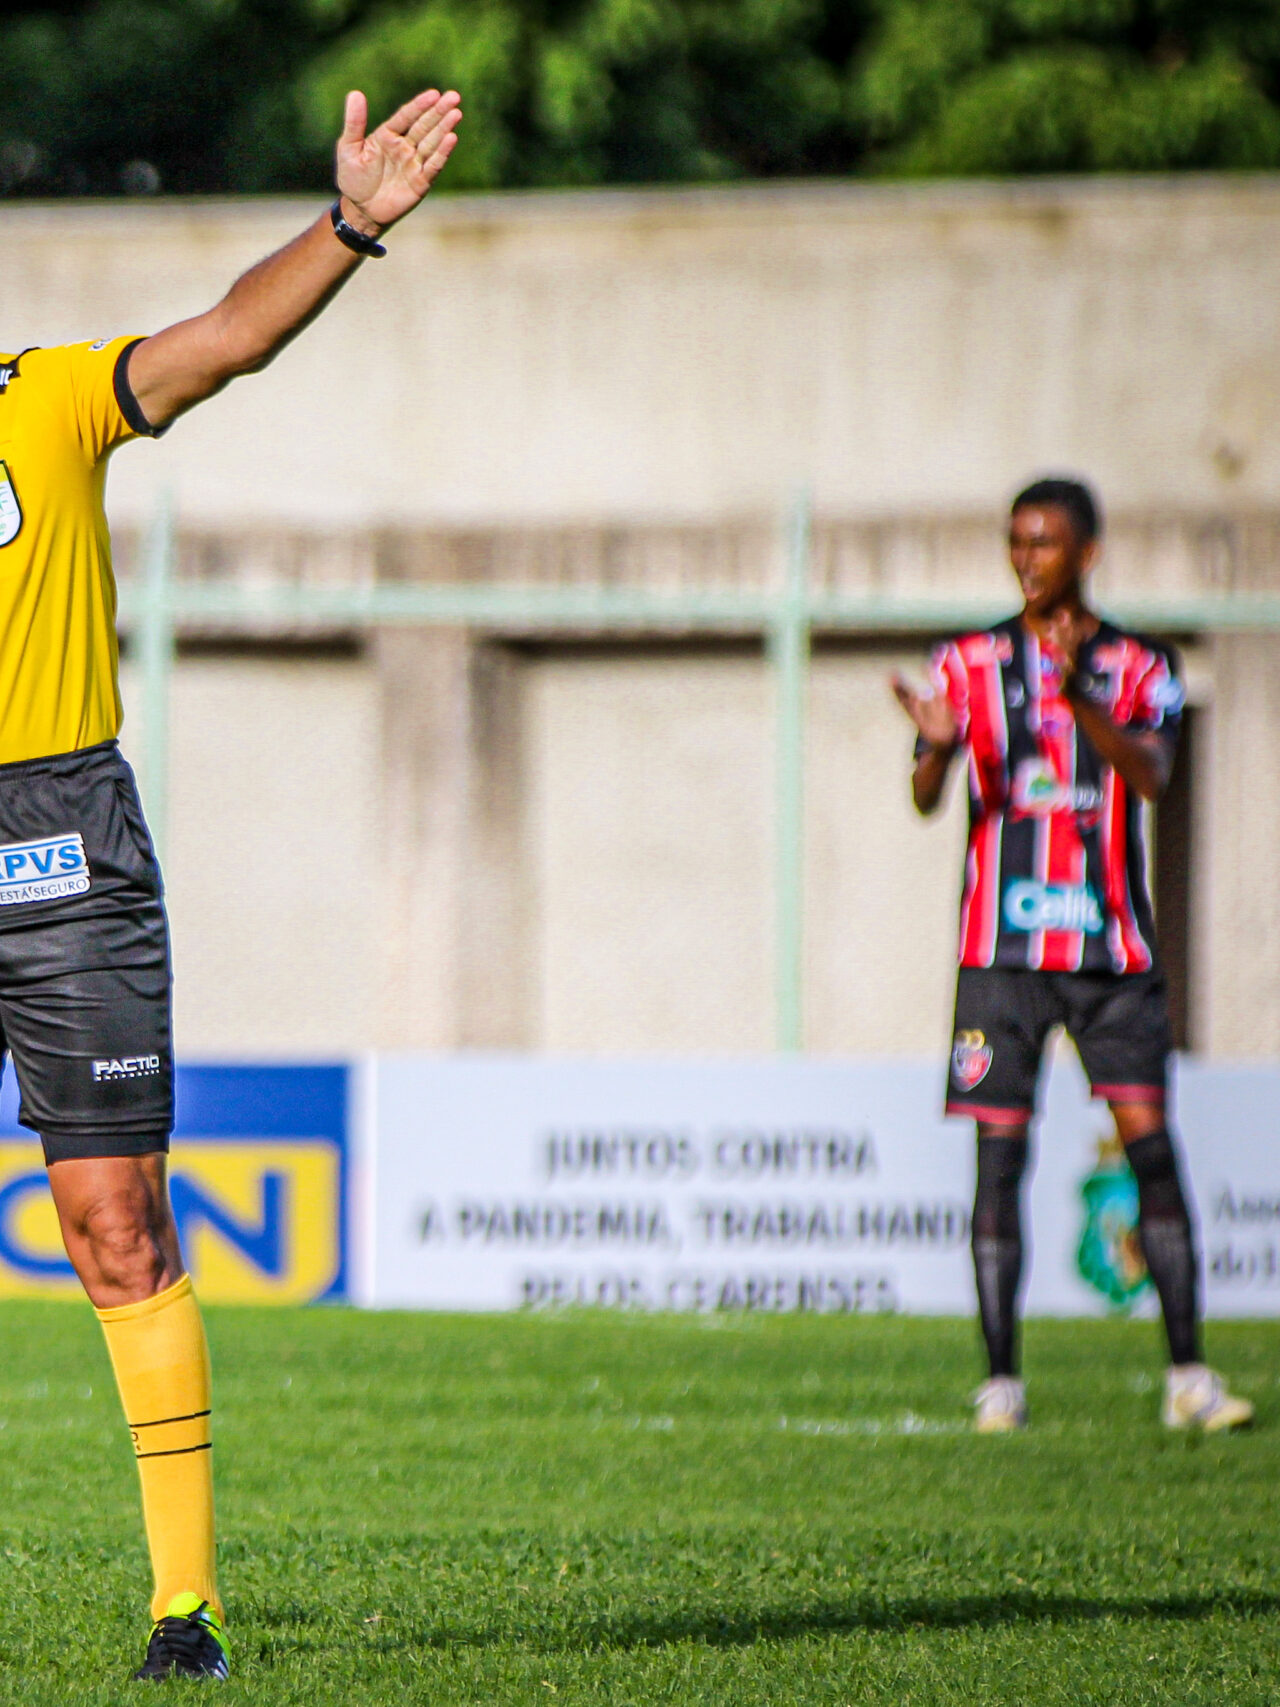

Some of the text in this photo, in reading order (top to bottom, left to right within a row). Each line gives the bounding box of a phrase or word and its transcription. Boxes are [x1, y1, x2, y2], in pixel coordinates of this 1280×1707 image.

[33, 878, 88, 897] SEGURO
[94, 1054, 160, 1075] FACTIO
[542, 1133, 878, 1182] JUNTOS CONTRA
[694, 1202, 974, 1246] TRABALHAND
